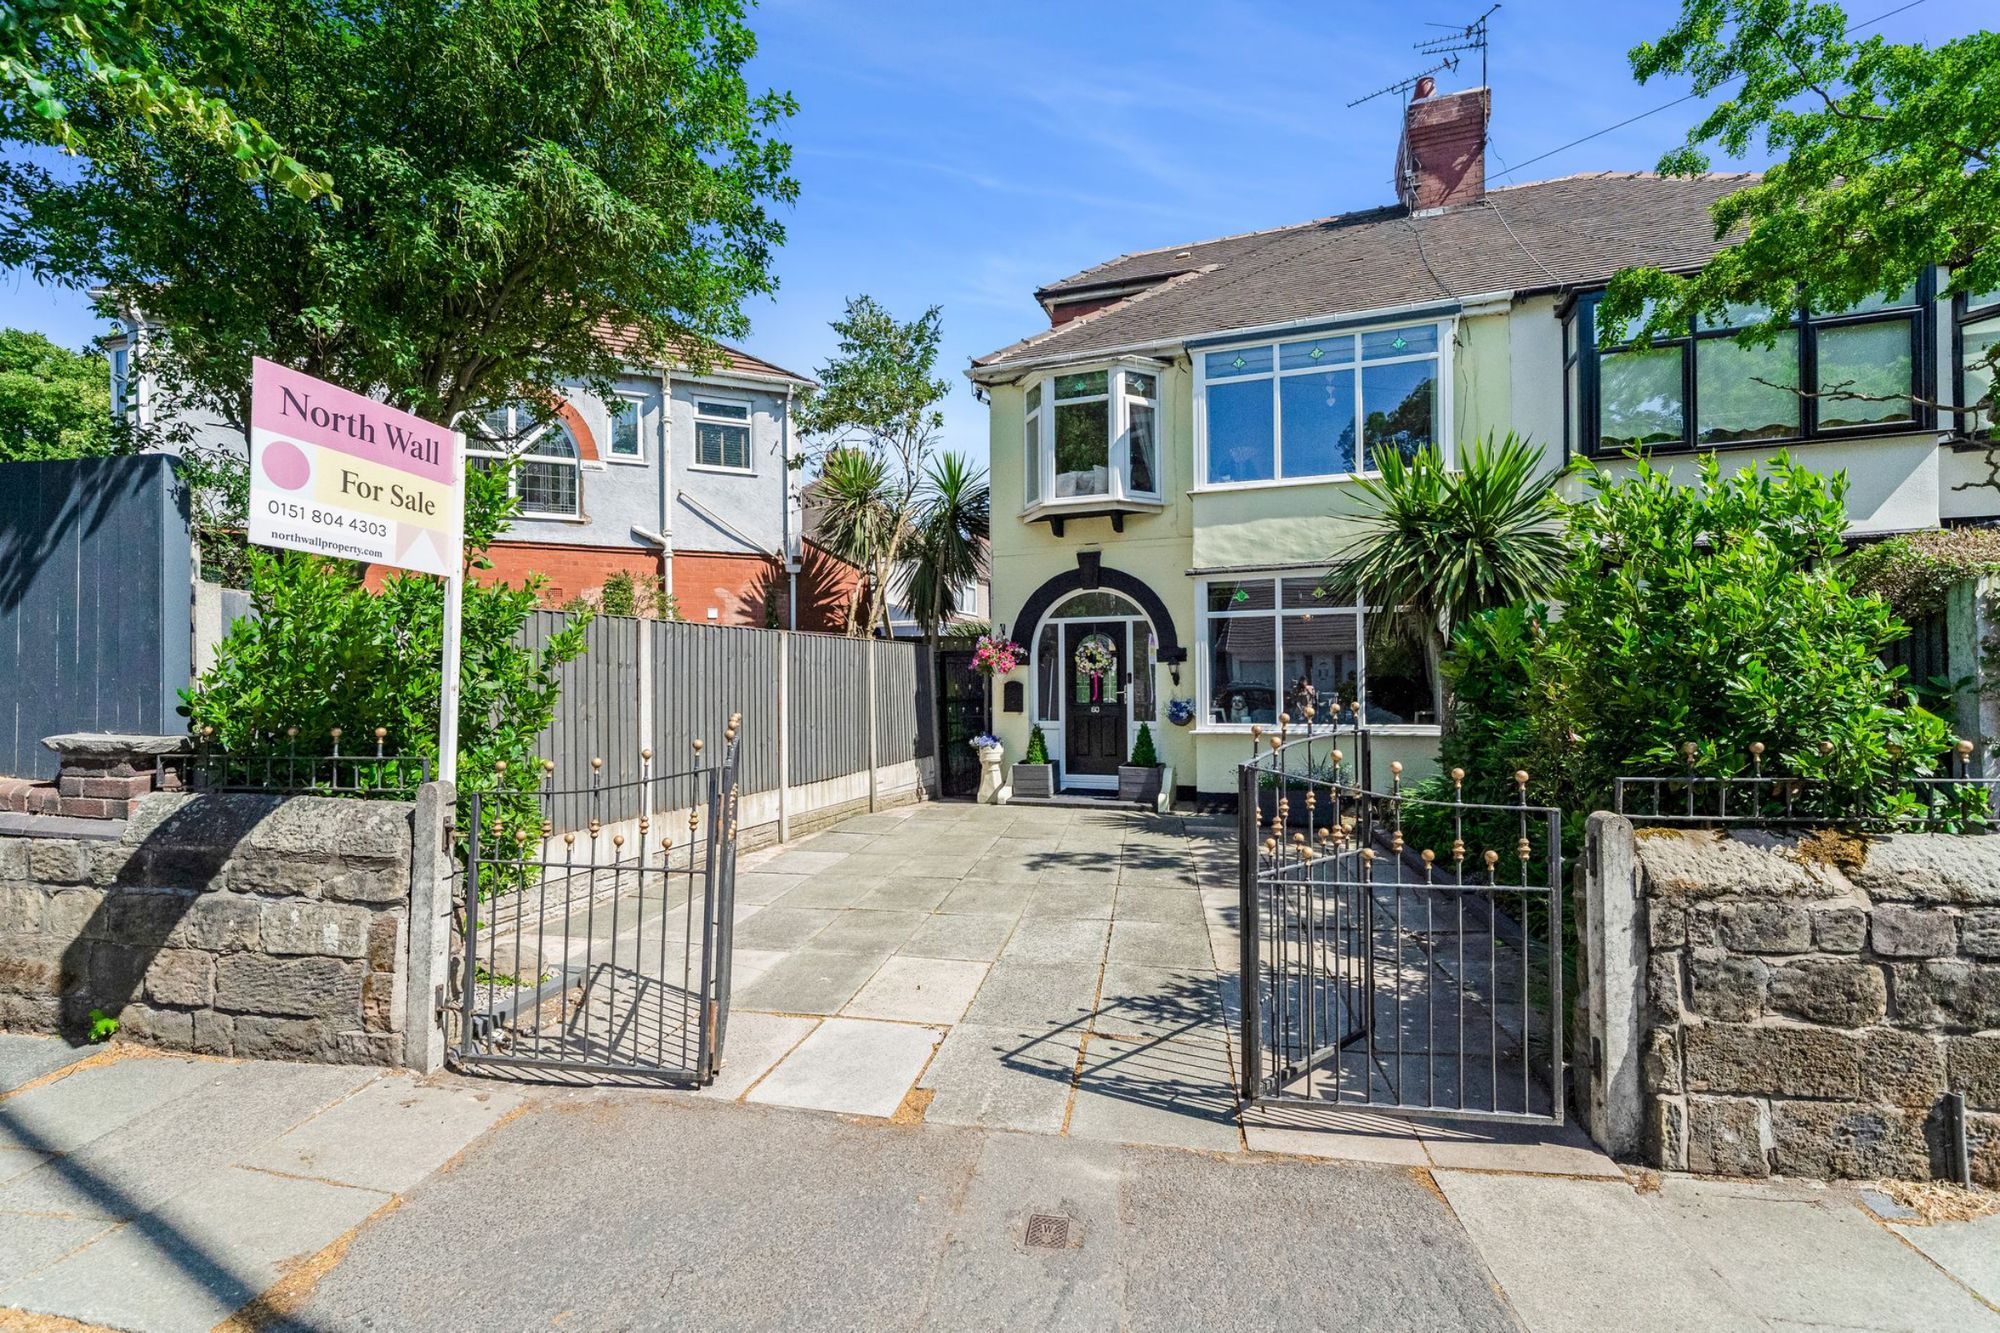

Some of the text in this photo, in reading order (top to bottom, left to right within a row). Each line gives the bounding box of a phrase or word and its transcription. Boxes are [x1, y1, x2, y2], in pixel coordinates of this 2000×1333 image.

[279, 385, 440, 466] North Wall
[340, 469, 436, 516] For Sale
[268, 500, 388, 538] 0151 804 4303
[271, 530, 383, 558] northwallproperty.com
